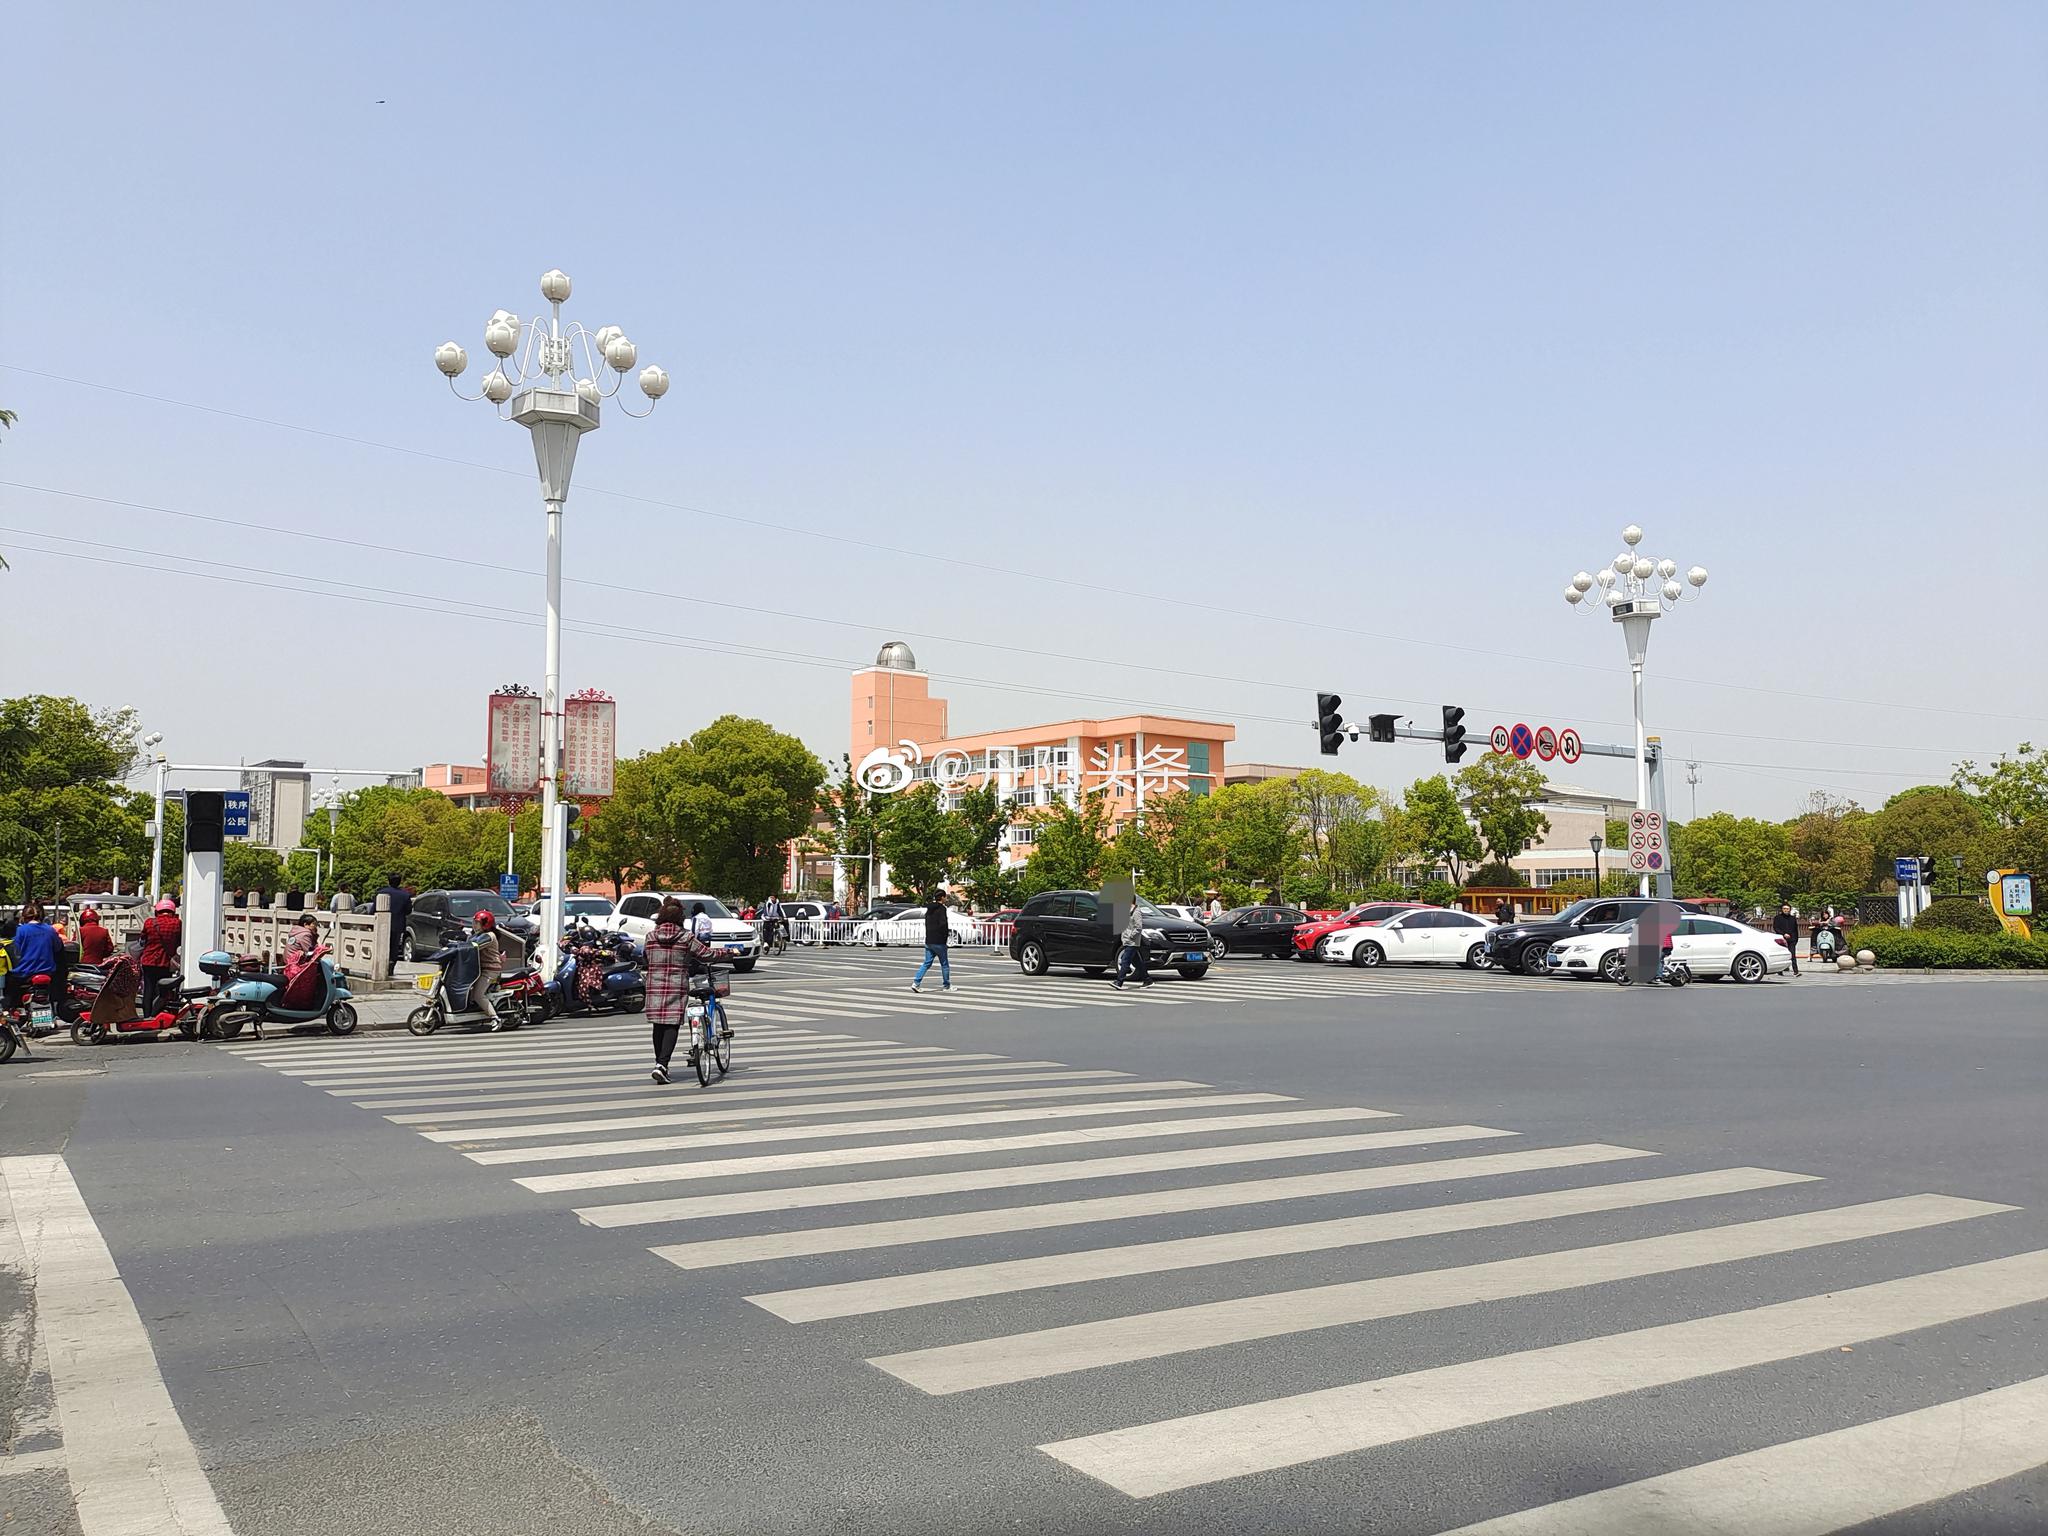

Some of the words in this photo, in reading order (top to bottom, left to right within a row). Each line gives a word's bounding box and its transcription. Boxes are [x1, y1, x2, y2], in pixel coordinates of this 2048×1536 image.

[1495, 734, 1506, 746] 40
[601, 721, 609, 789] 以习近平新时代中国
[224, 800, 248, 810] 秩序
[224, 817, 247, 826] 公民
